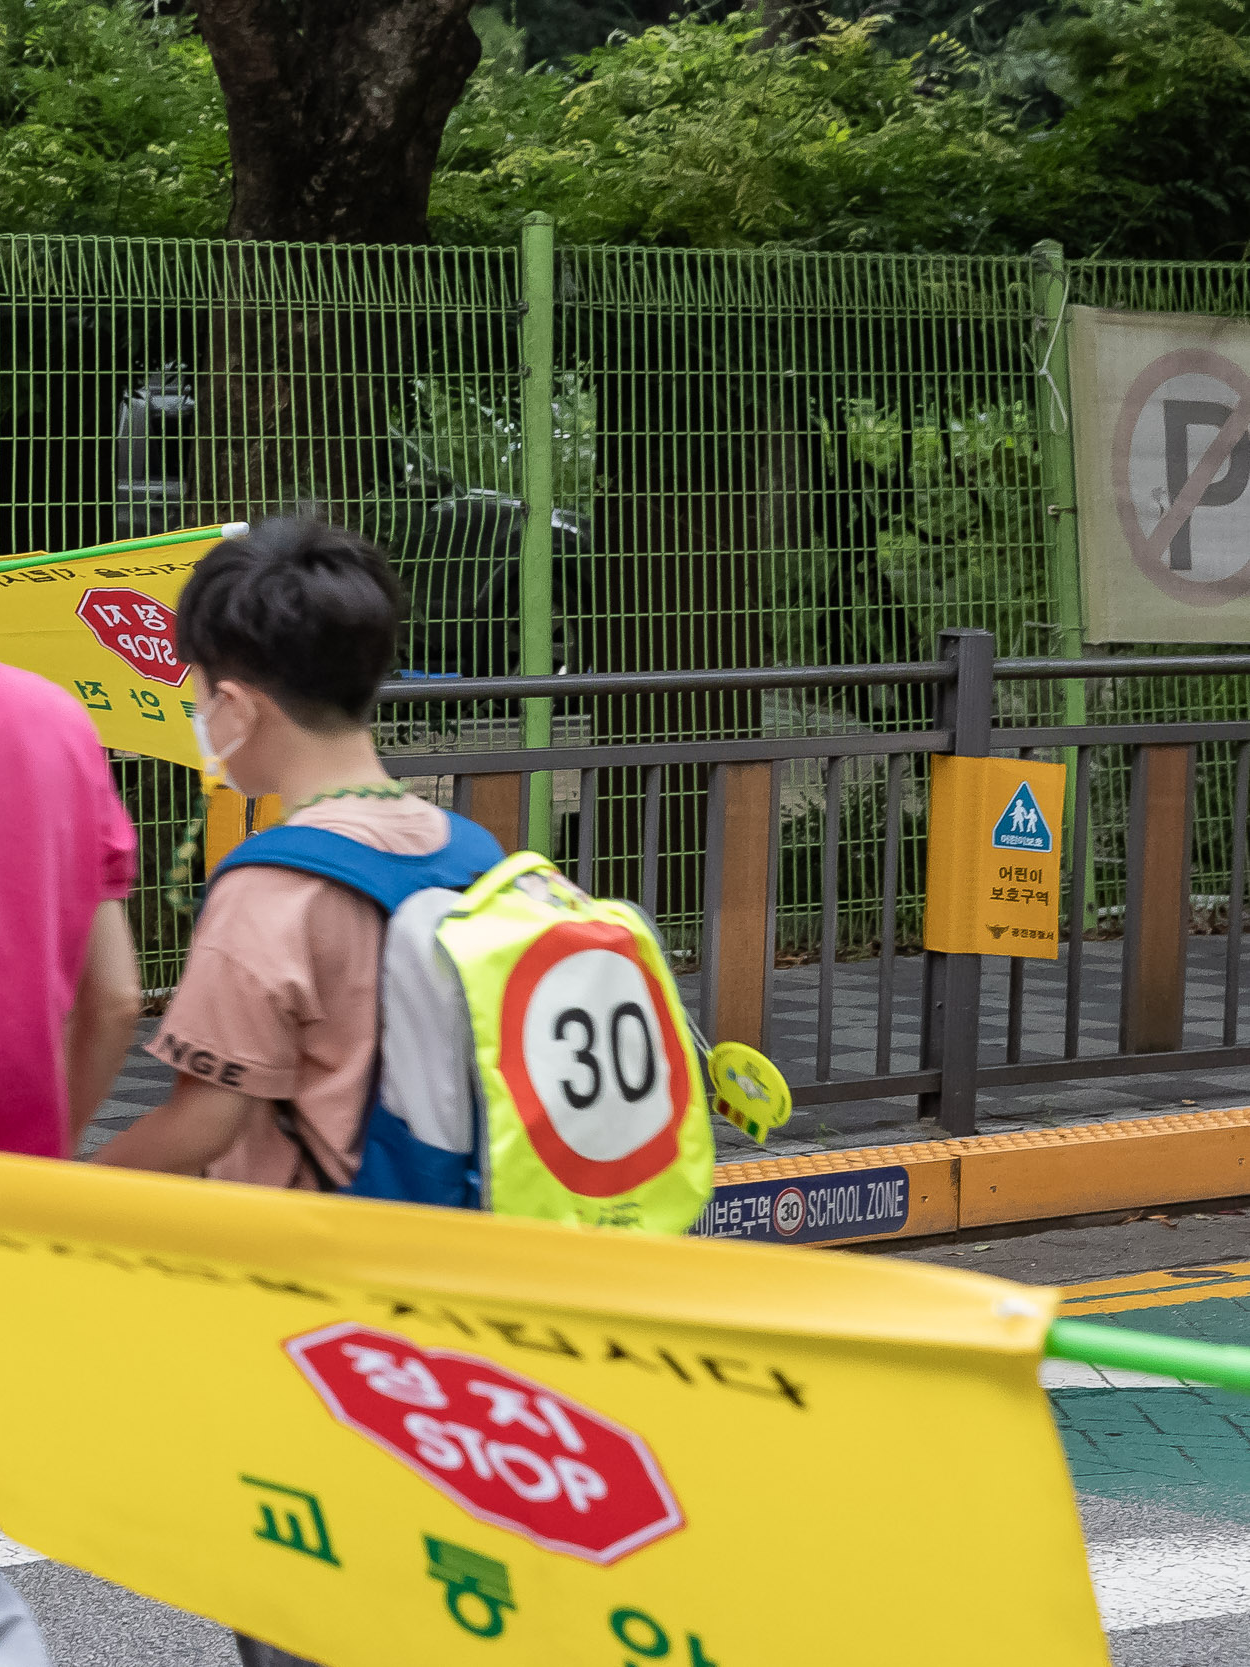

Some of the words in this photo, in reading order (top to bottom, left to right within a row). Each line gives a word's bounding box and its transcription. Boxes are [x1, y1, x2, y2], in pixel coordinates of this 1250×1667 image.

[989, 886, 1049, 907] 보호구역
[998, 865, 1043, 884] 어린이
[553, 1001, 656, 1110] 30
[780, 1201, 800, 1222] 30
[806, 1184, 864, 1228] SCHOOL
[866, 1179, 905, 1220] ZONE
[403, 1411, 609, 1515] STOP
